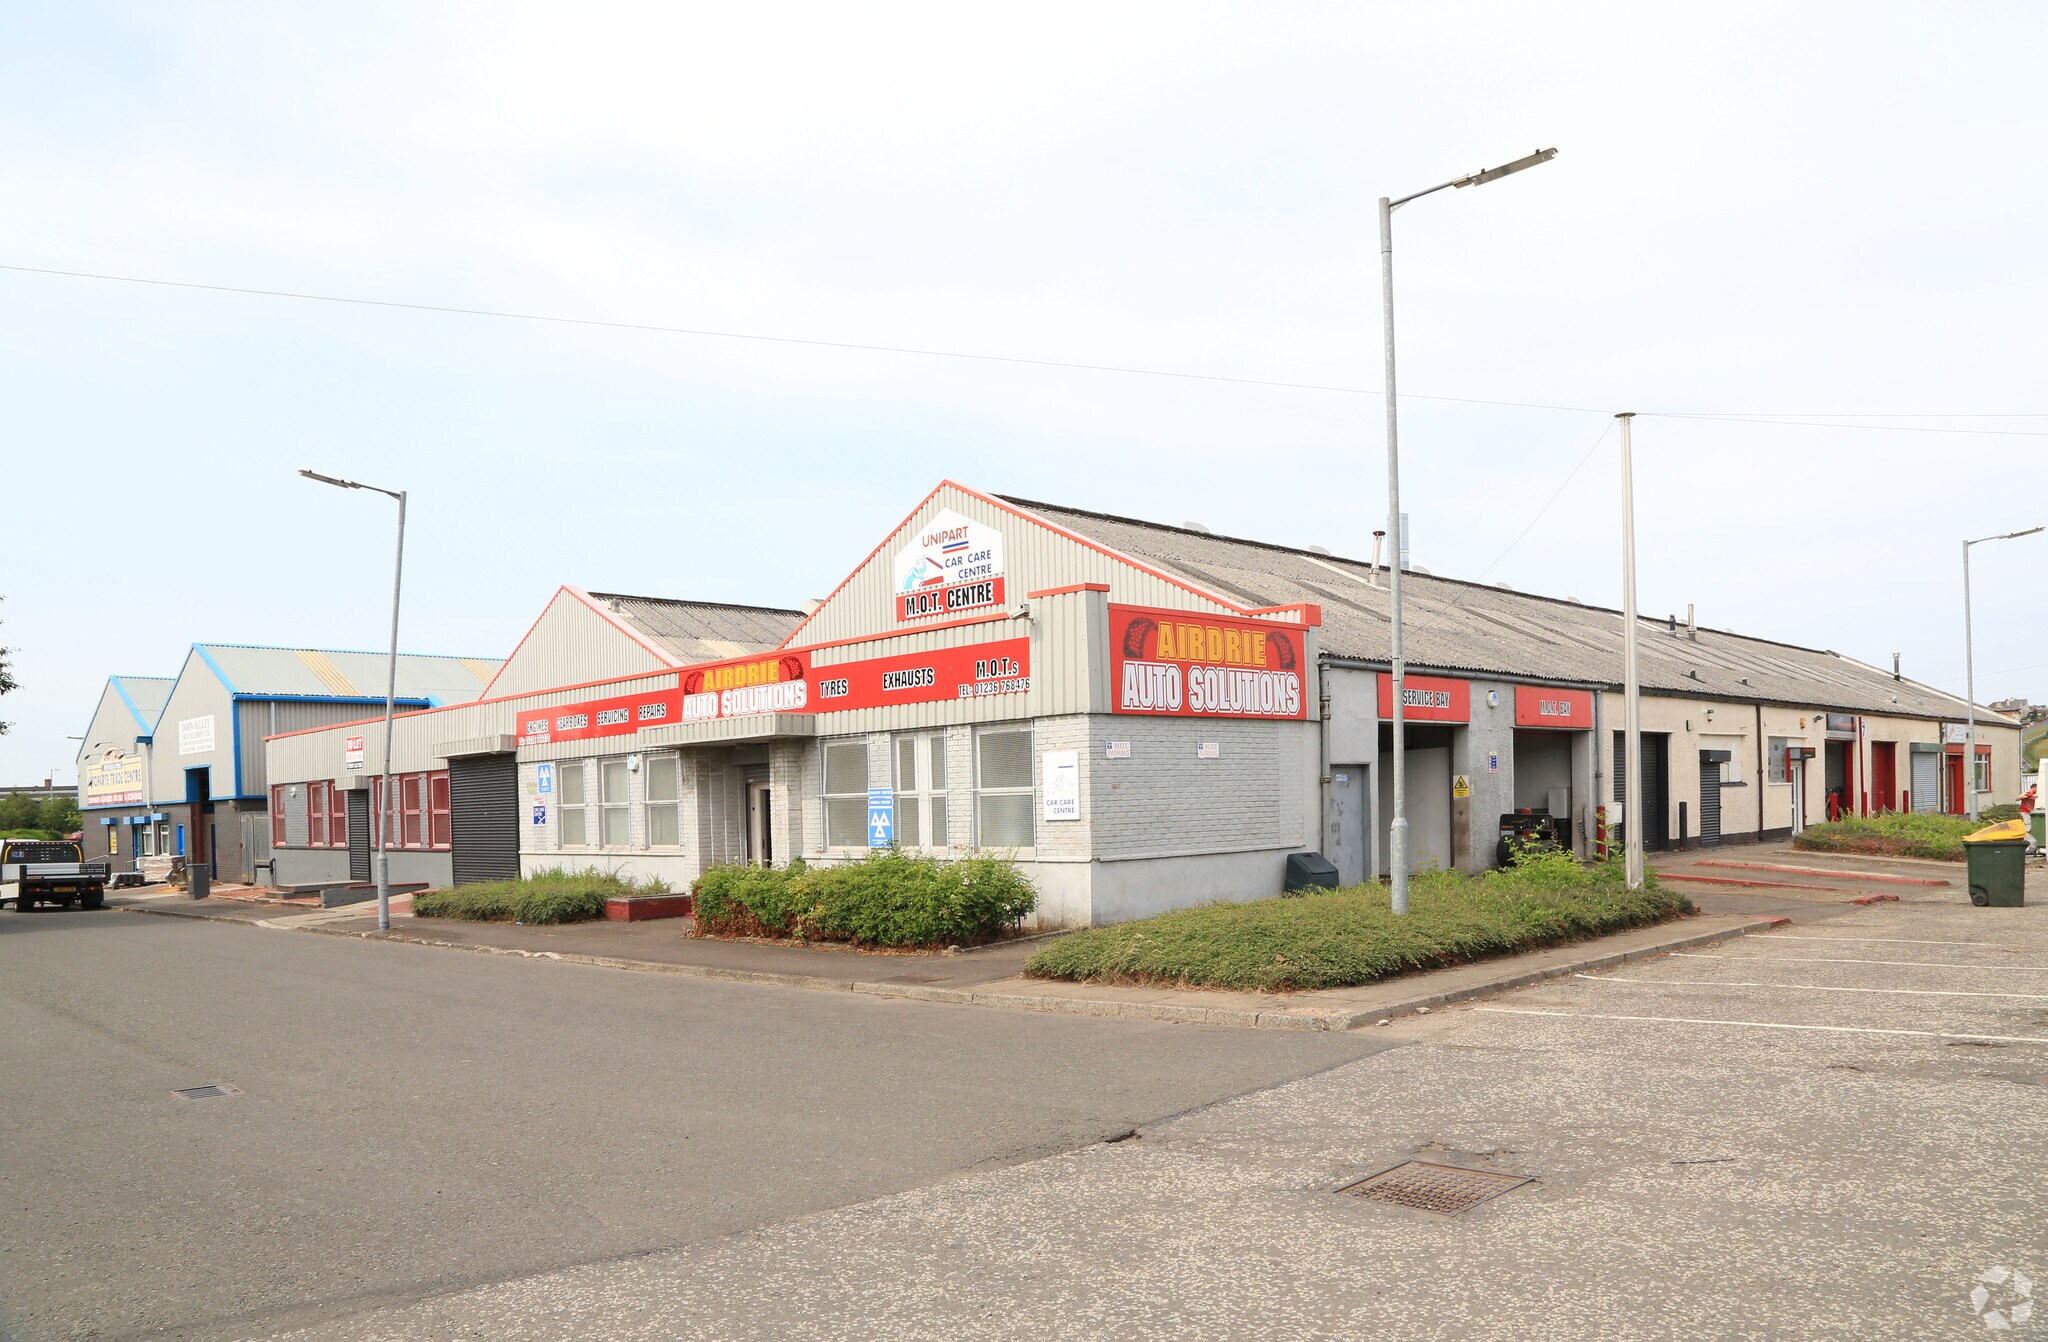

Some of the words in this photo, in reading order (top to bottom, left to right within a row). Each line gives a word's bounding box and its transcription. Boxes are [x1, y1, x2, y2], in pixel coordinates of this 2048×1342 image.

[922, 526, 969, 547] UNIPART
[945, 556, 963, 568] CAR
[967, 549, 992, 563] CARE
[958, 563, 992, 579] CENTRE
[905, 592, 942, 616] M.O.T.
[947, 582, 992, 608] CENTRE
[1156, 621, 1267, 667] AIRDRIE
[702, 659, 780, 693] AIRDRIE
[883, 668, 934, 690] EXHAUSTS
[820, 679, 848, 698] TYRES
[958, 684, 973, 697] TEL:
[974, 681, 998, 695] 01236
[1000, 678, 1030, 693] 768476
[1121, 660, 1182, 711] AUTO
[1188, 665, 1300, 716] SOLUTIONS
[682, 692, 718, 722] AUTO
[721, 679, 807, 717] SOLUTIONS
[1402, 689, 1434, 707] SERVICE
[1435, 691, 1450, 709] BAY
[1539, 700, 1558, 716] M.O.T.
[1559, 701, 1572, 717] BAY
[597, 708, 629, 726] SERVICING
[638, 703, 667, 721] REPAIRS
[194, 718, 210, 730] VALLEY
[526, 719, 549, 735] ENGINES
[556, 714, 588, 731] GEARBOXES
[346, 739, 353, 750] TO
[353, 738, 363, 749] LET
[111, 772, 123, 785] TRADE
[124, 769, 141, 784] CENTRE
